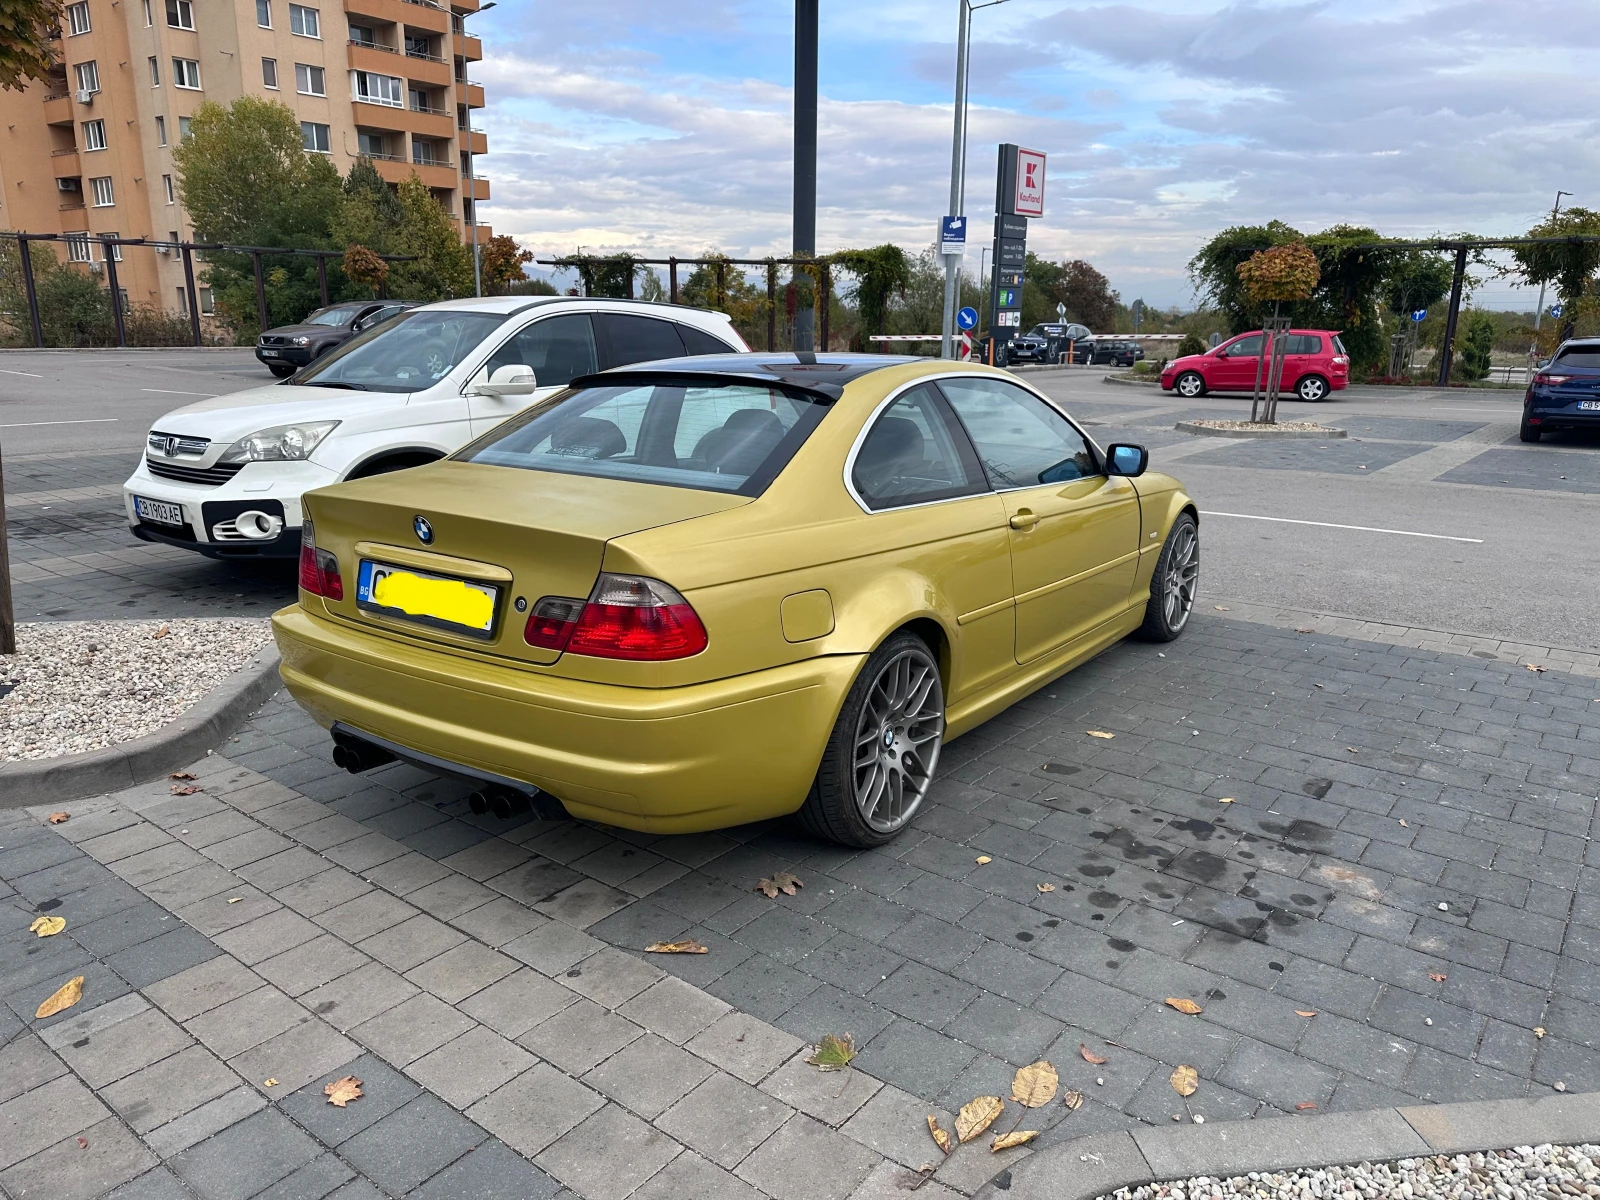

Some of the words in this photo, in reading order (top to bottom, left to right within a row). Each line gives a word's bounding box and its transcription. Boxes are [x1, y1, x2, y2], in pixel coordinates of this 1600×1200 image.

[1025, 162, 1037, 189] K
[1019, 192, 1041, 204] Kaufland
[1008, 292, 1013, 304] P
[138, 500, 149, 516] CB
[149, 502, 168, 520] 1903
[169, 507, 181, 523] AE
[359, 585, 369, 596] BG
